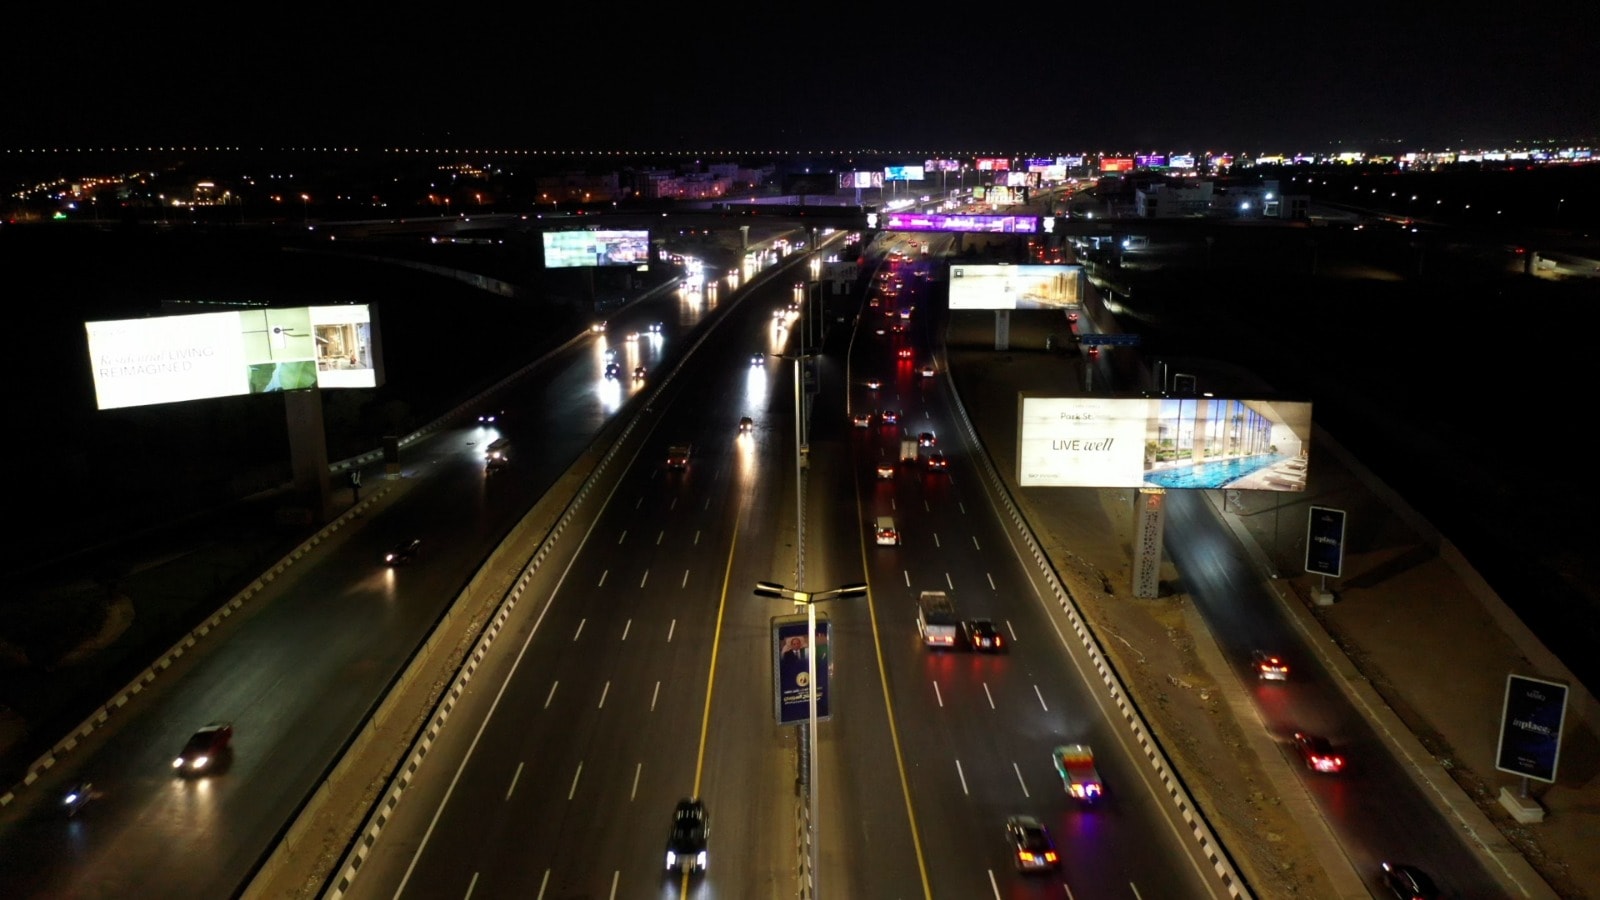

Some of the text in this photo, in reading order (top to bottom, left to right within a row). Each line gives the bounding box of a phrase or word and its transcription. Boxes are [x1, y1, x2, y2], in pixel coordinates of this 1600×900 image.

[168, 346, 215, 359] LIVING
[99, 360, 194, 378] REIMAGINED
[1060, 411, 1081, 420] Park
[1052, 437, 1115, 451] LIVE well
